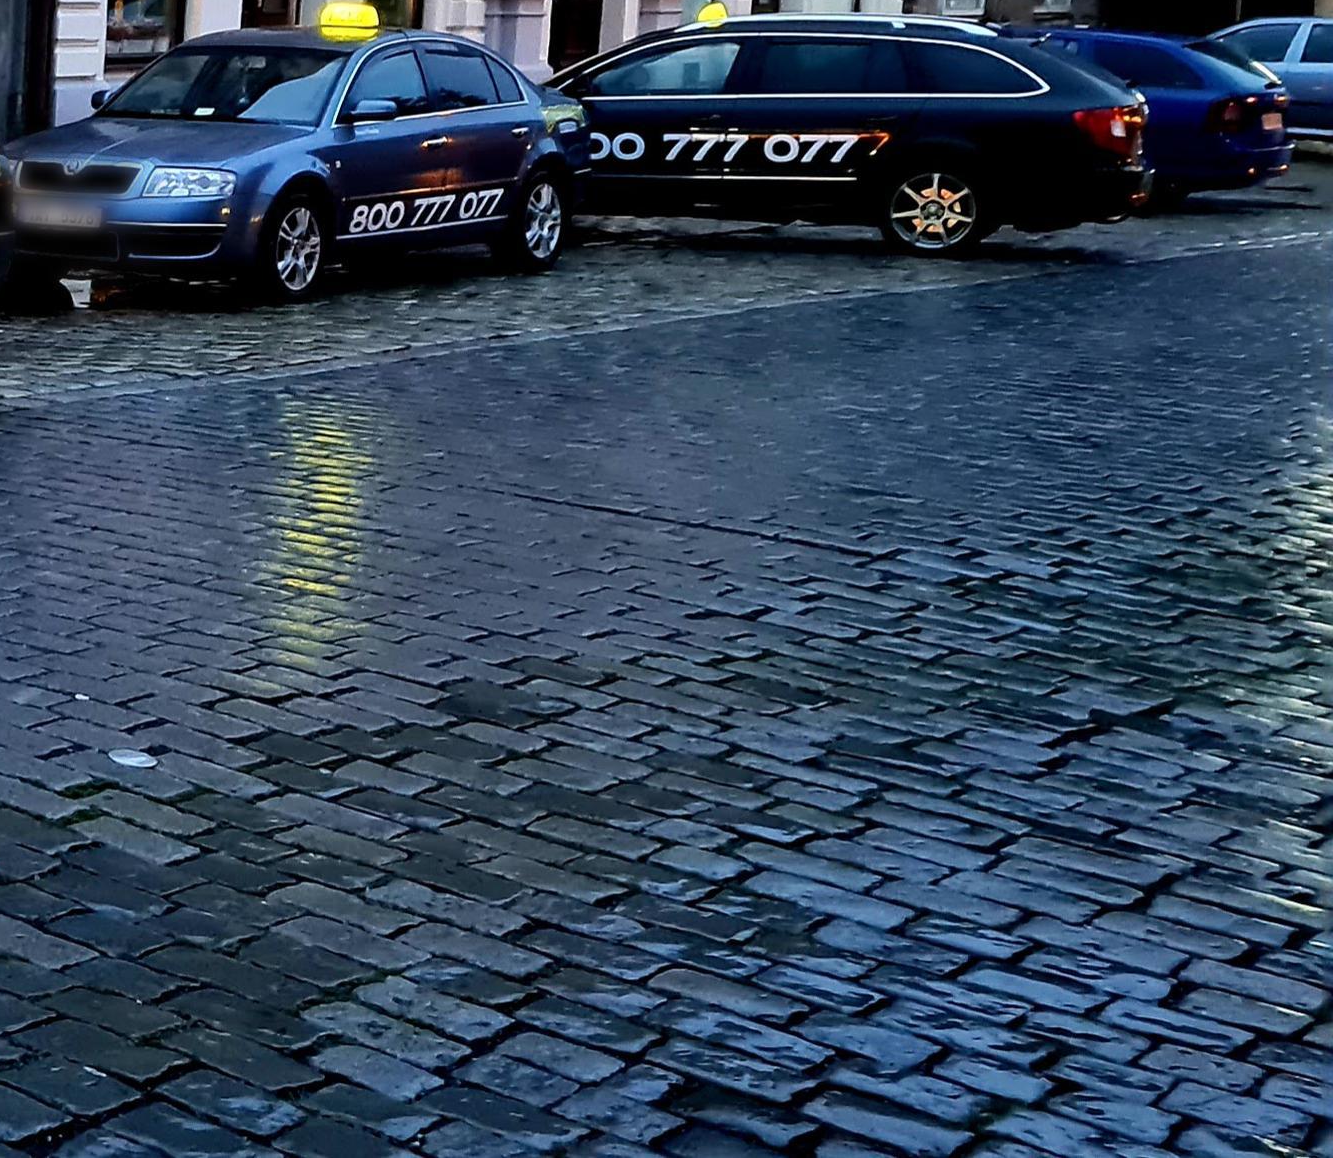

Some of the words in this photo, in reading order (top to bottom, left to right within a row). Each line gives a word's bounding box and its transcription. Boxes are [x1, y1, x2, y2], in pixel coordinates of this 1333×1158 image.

[663, 133, 749, 161] 777
[764, 133, 861, 162] 077
[348, 200, 406, 233] 800
[410, 194, 456, 226] 777
[459, 188, 504, 219] 077
